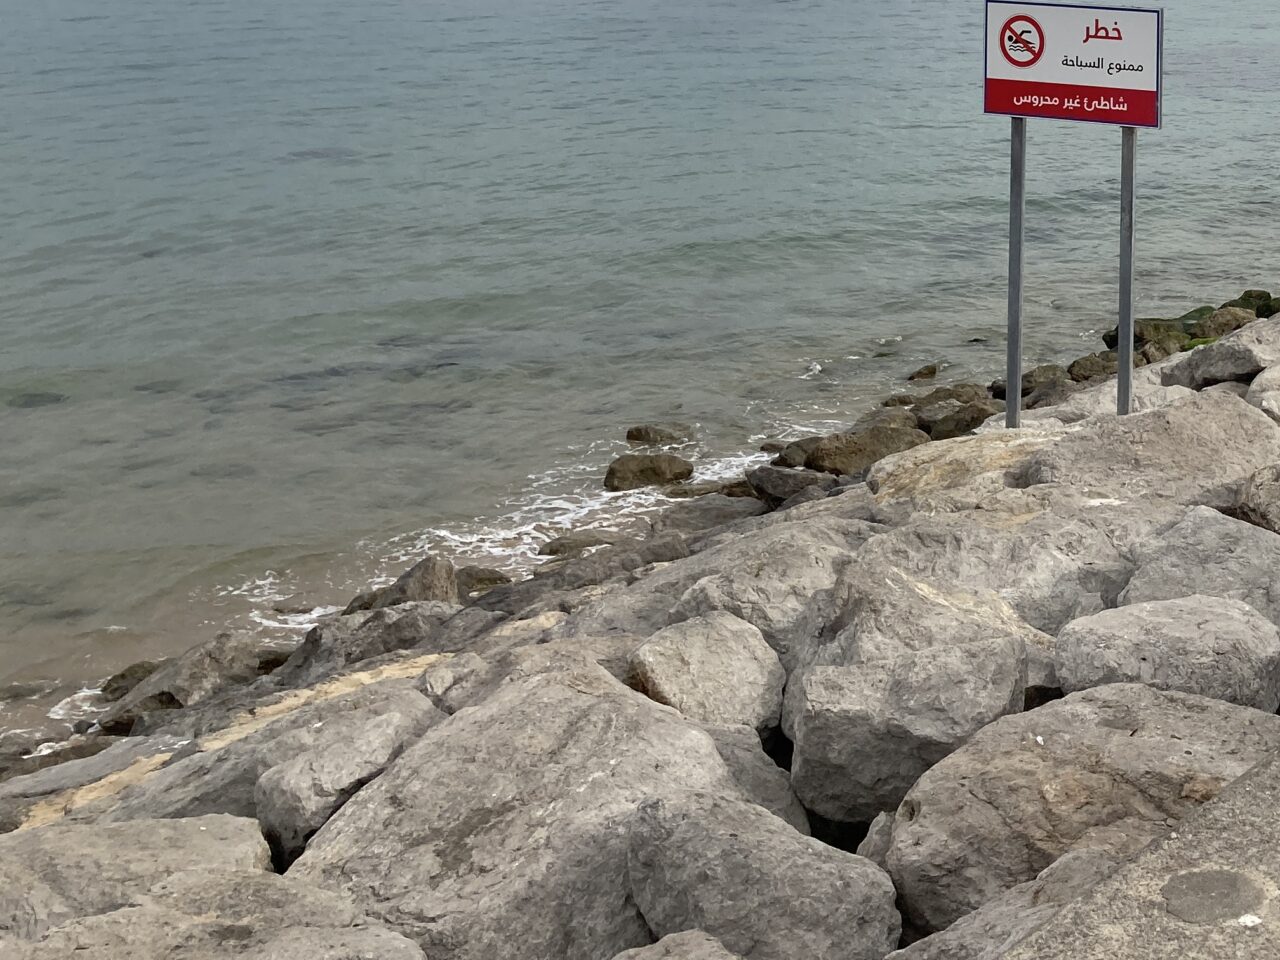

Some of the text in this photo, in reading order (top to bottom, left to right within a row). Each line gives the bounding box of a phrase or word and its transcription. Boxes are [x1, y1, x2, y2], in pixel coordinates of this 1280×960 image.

[1083, 18, 1123, 44] خطر
[1061, 55, 1144, 75] ممنوع السباحة
[1013, 95, 1128, 111] شاطئ غير محروس
